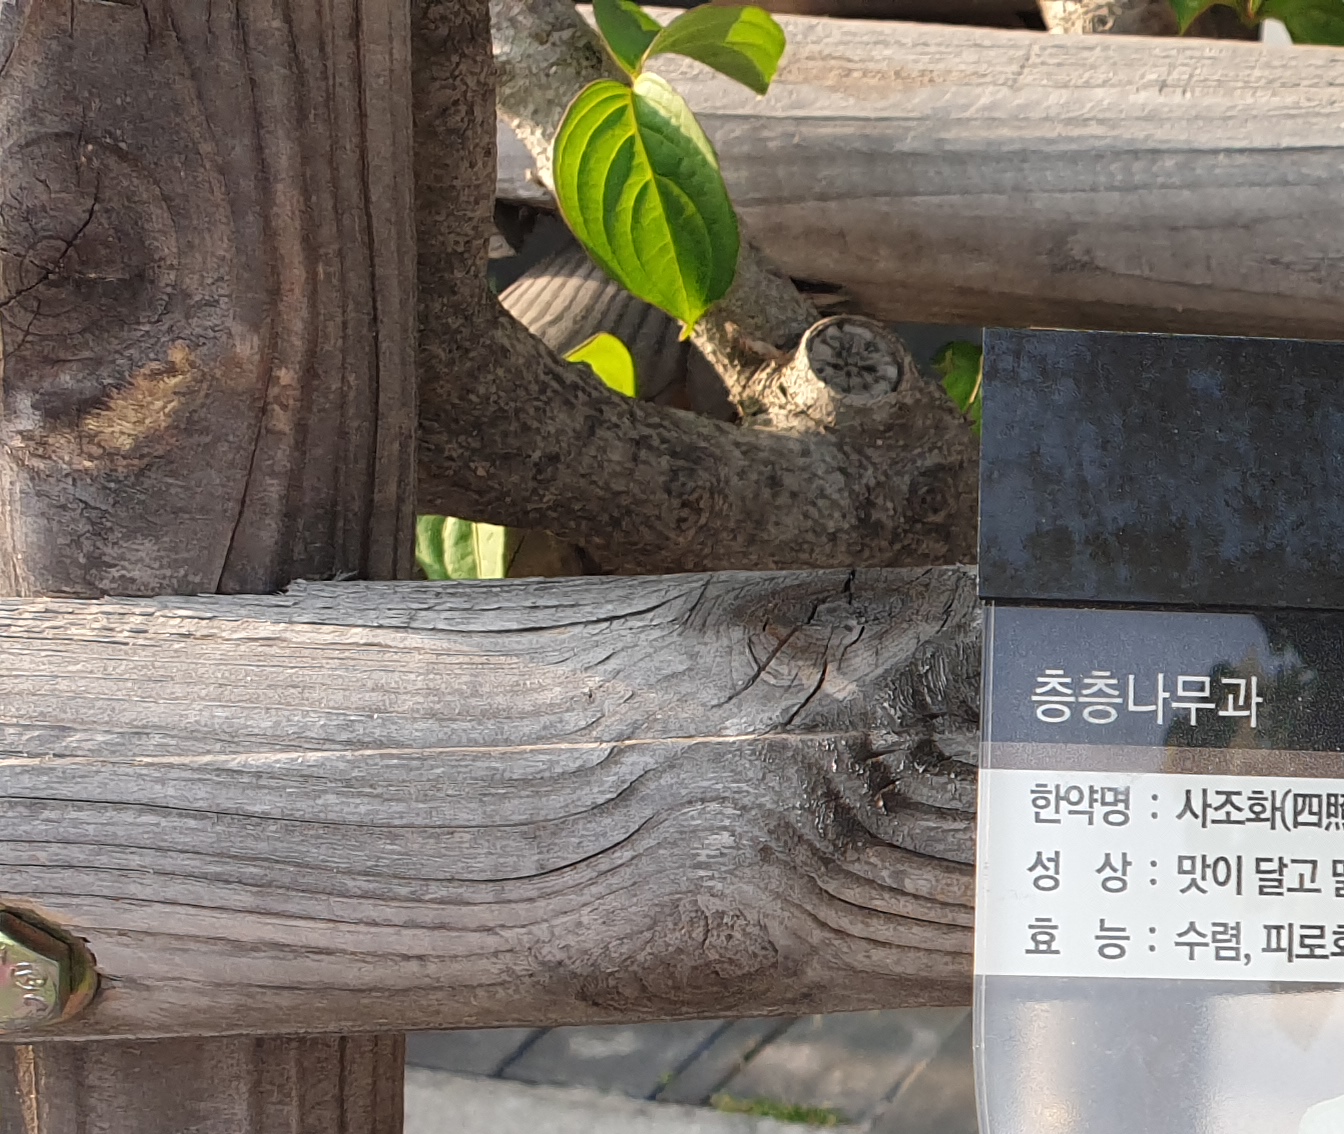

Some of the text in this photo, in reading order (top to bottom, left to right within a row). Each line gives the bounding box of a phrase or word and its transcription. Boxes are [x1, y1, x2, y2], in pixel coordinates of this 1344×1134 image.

[1031, 669, 1263, 728] 층층나무과
[1030, 783, 1131, 827] 한약명
[1176, 854, 1243, 895] 맛이
[1254, 856, 1322, 897] 달고
[1174, 921, 1252, 966] 수렴,
